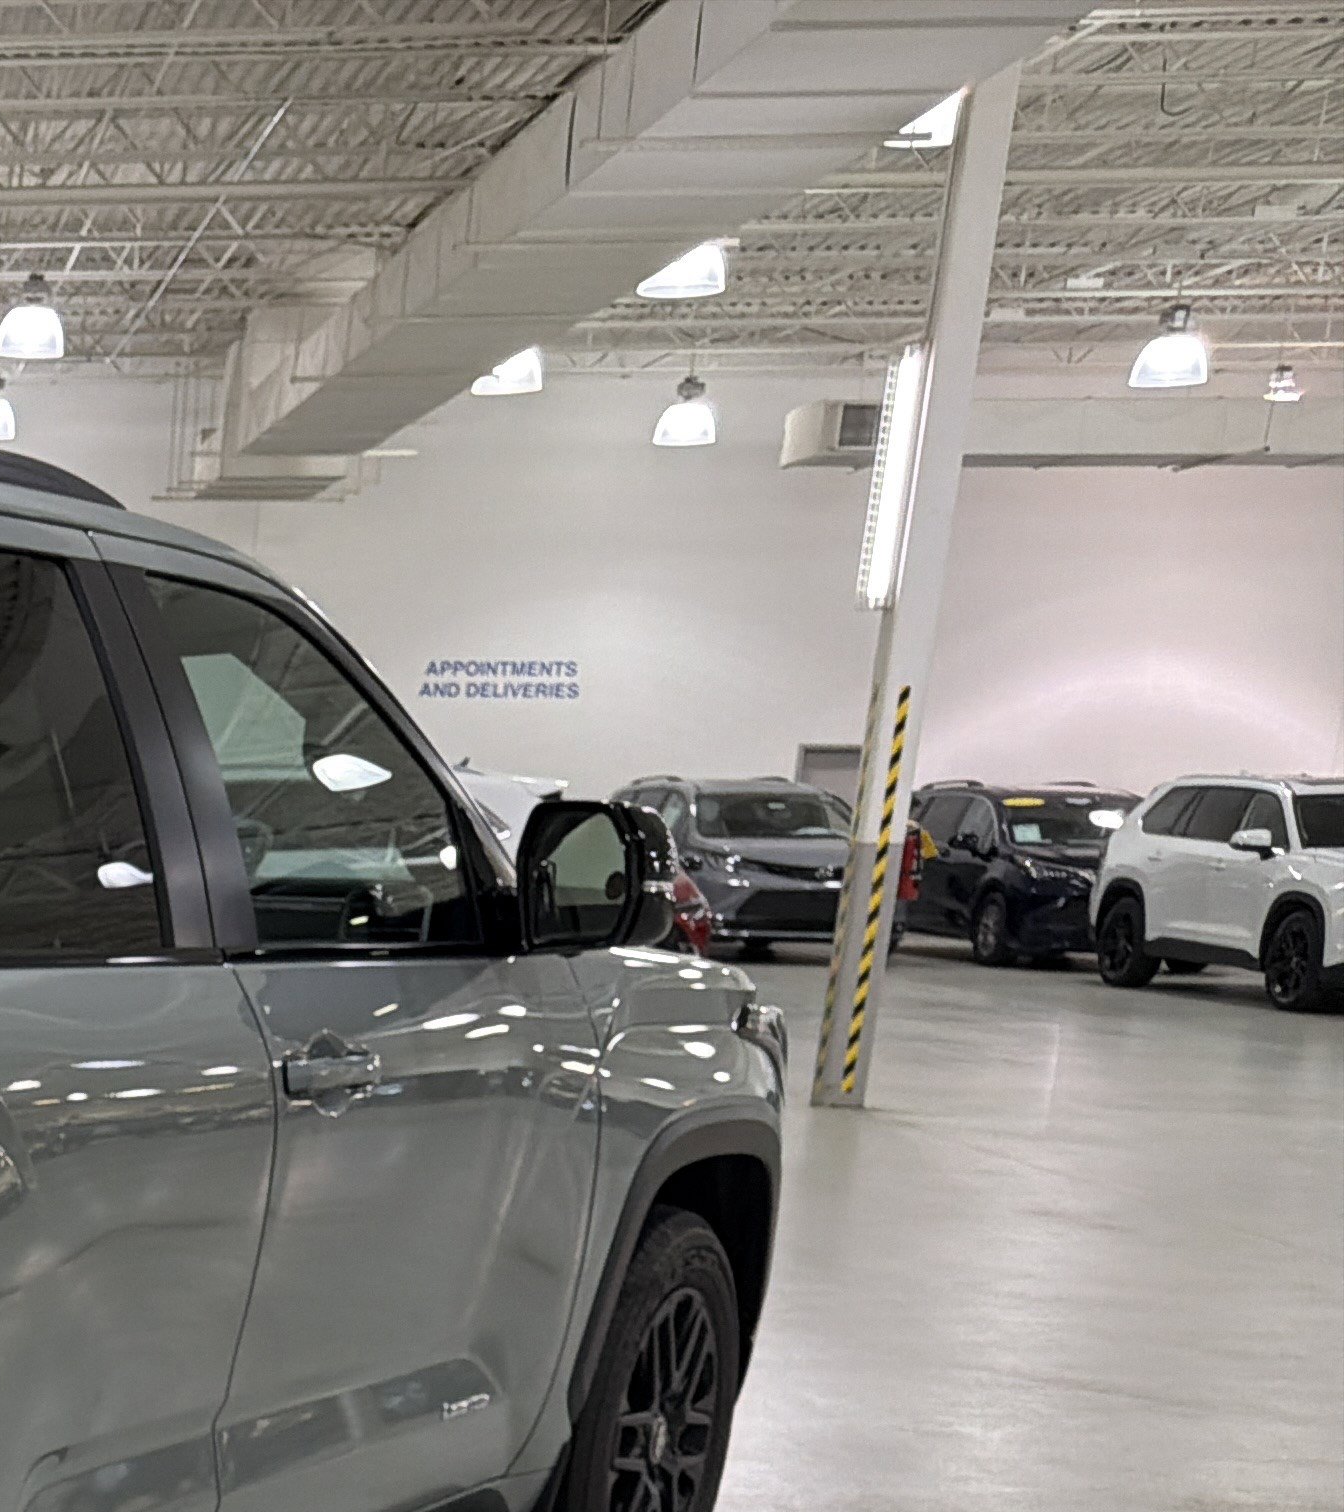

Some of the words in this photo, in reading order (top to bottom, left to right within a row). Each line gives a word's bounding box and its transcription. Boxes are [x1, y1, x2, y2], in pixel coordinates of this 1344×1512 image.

[425, 660, 579, 677] APPOINTMENTS
[419, 682, 461, 699] AND
[465, 682, 580, 700] DELIVERIES
